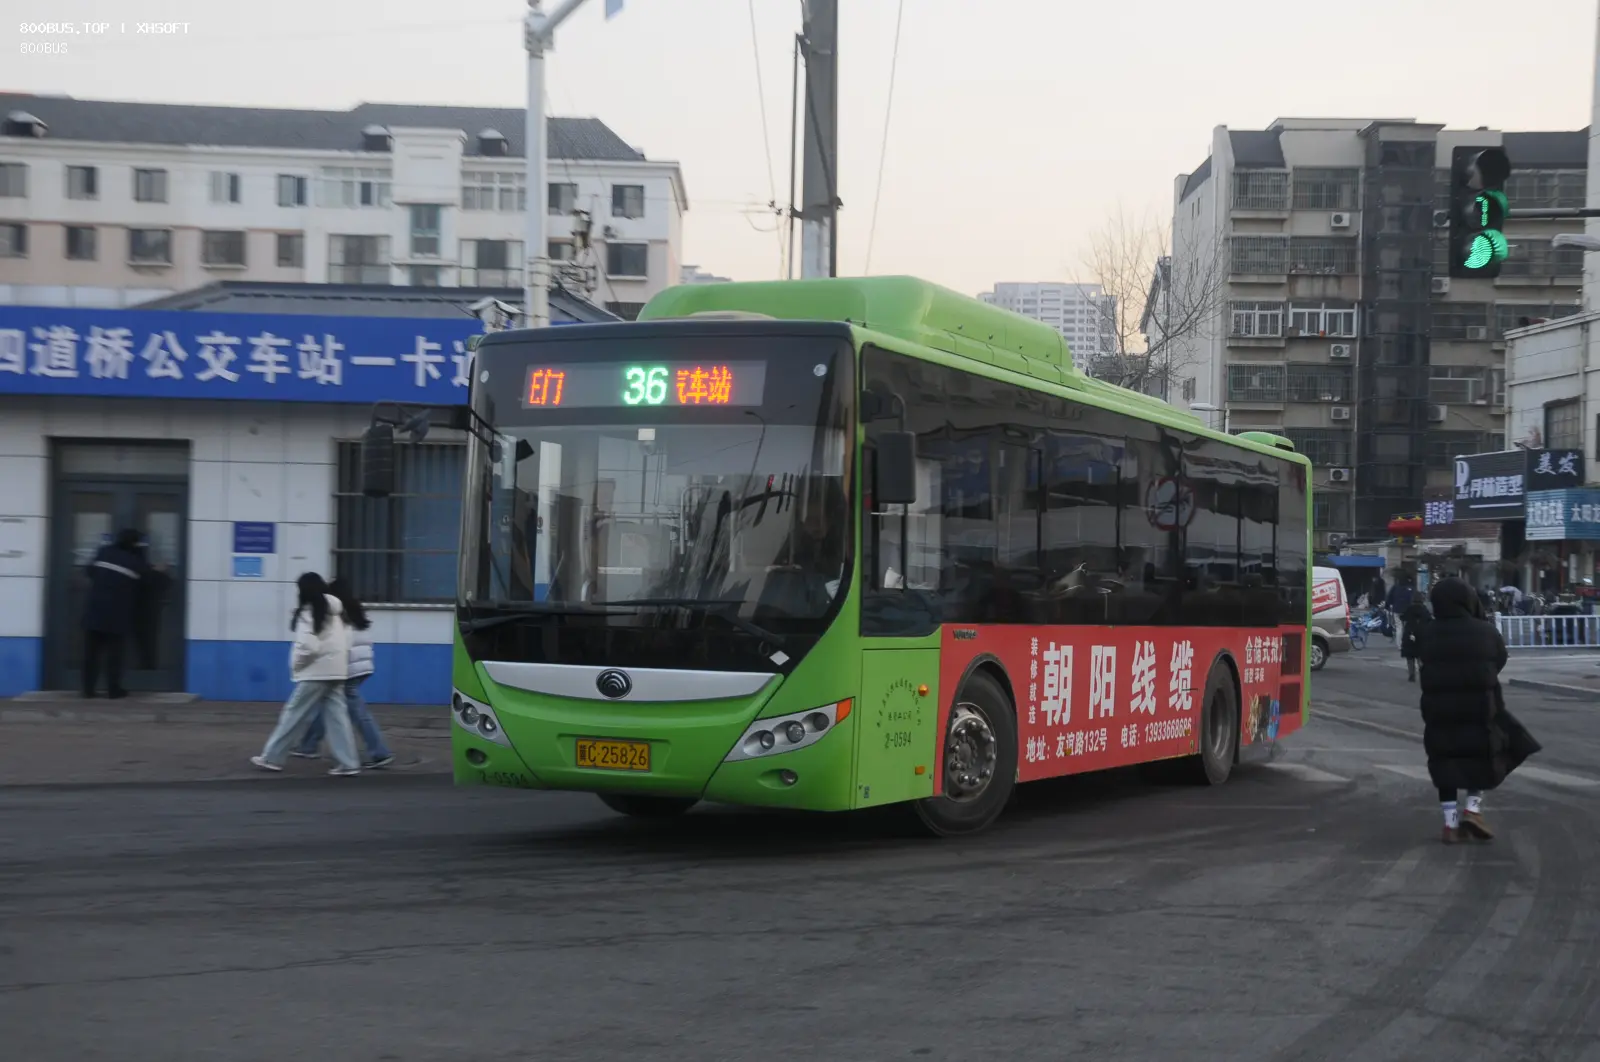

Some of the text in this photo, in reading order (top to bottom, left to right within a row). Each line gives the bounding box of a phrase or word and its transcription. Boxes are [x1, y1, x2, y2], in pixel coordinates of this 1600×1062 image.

[624, 366, 669, 405] 36
[1040, 639, 1194, 727] 朝阳线缆
[884, 731, 912, 749] 2-0594
